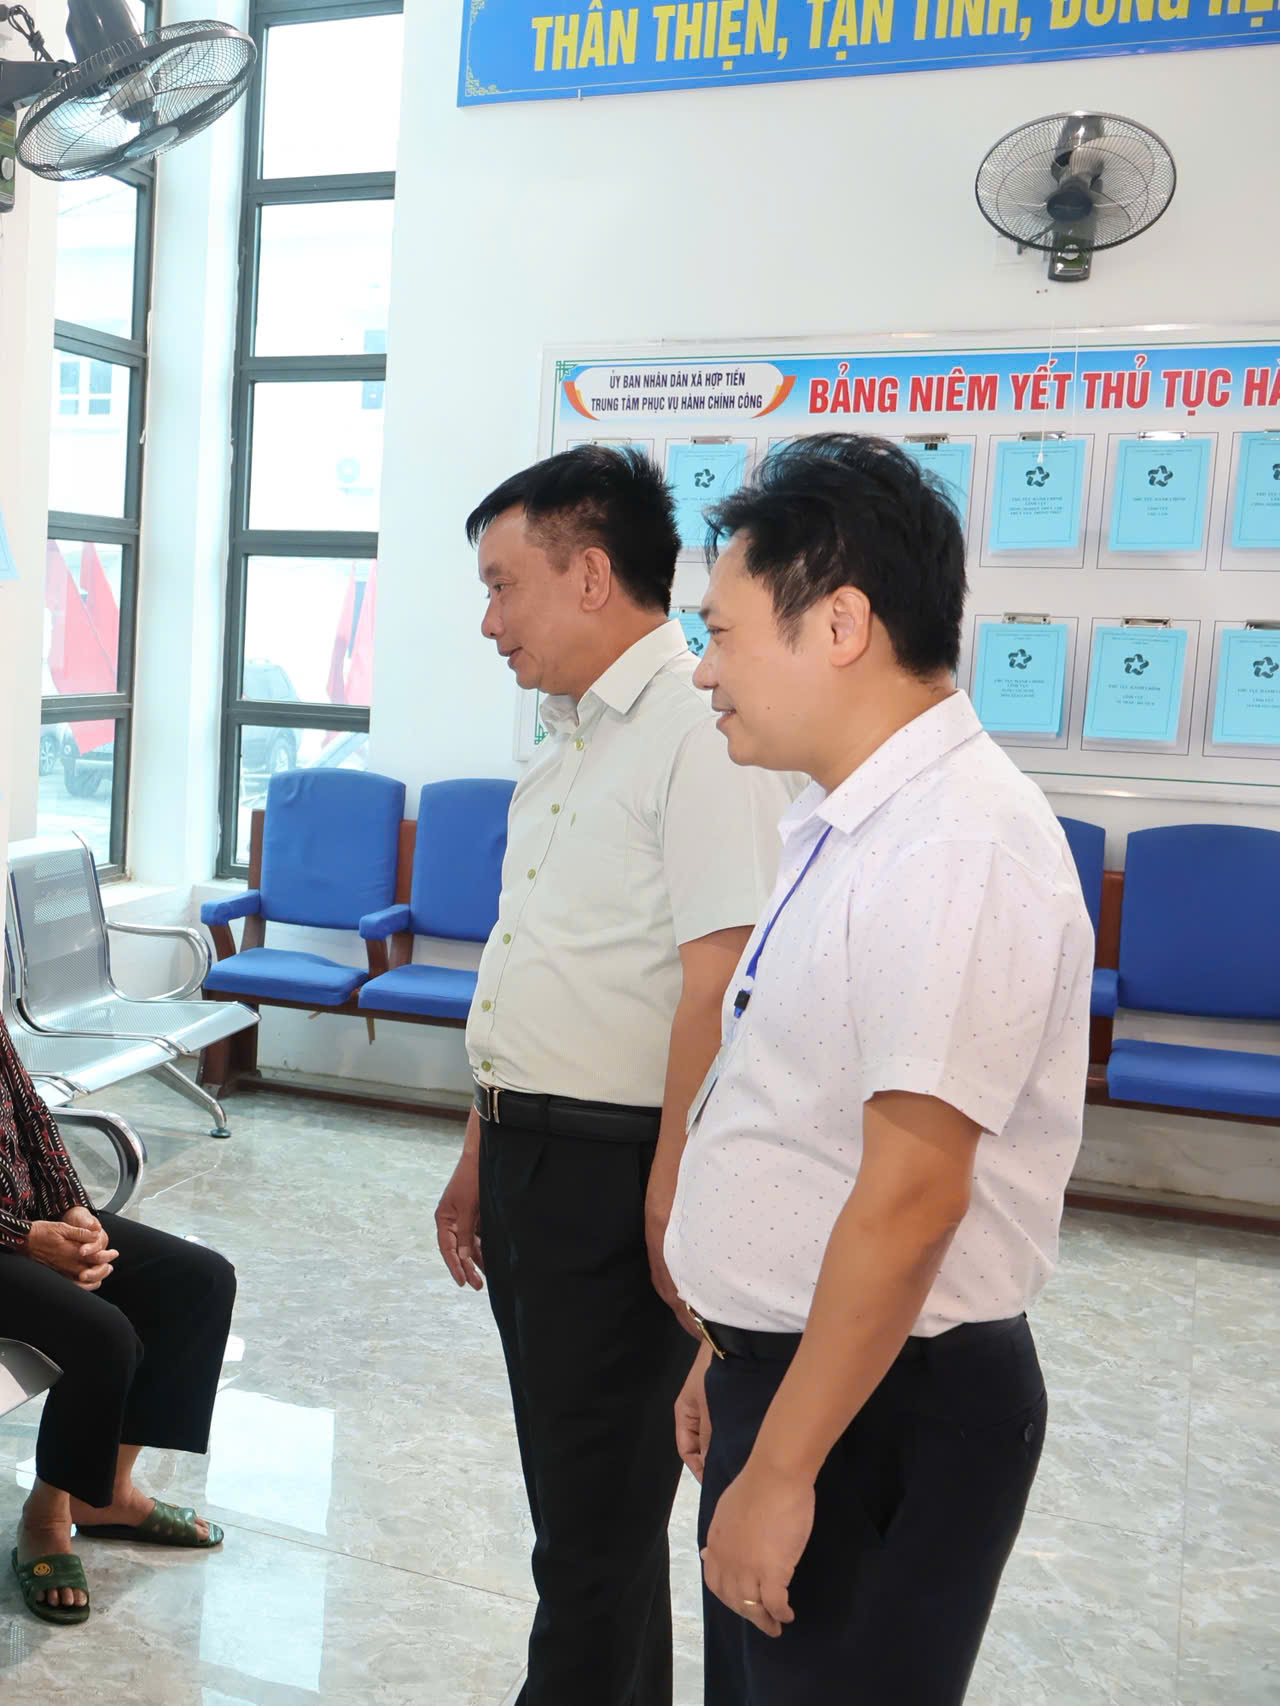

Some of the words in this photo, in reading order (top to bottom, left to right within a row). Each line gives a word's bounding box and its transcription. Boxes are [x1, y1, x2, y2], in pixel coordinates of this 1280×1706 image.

[531, 0, 639, 72] THÂN
[623, 374, 641, 389] BAN
[643, 371, 668, 388] NHÂN
[670, 371, 688, 388] DÂN
[690, 370, 703, 387] XÃ
[705, 371, 723, 389] HỢP
[726, 368, 746, 387] TIẾN
[808, 362, 900, 416] BẢNG
[908, 367, 999, 413] NIÊM
[1009, 358, 1073, 412] YẾT
[1081, 354, 1153, 410] THỦ
[1162, 368, 1231, 417] TỤC
[591, 397, 619, 412] TRUNG
[621, 394, 640, 411] TÂM
[642, 396, 665, 413] PHỤC
[667, 396, 680, 413] VỤ
[681, 393, 705, 410] HÀNH
[708, 393, 735, 409] CHÍNH
[737, 393, 763, 409] CÔNG
